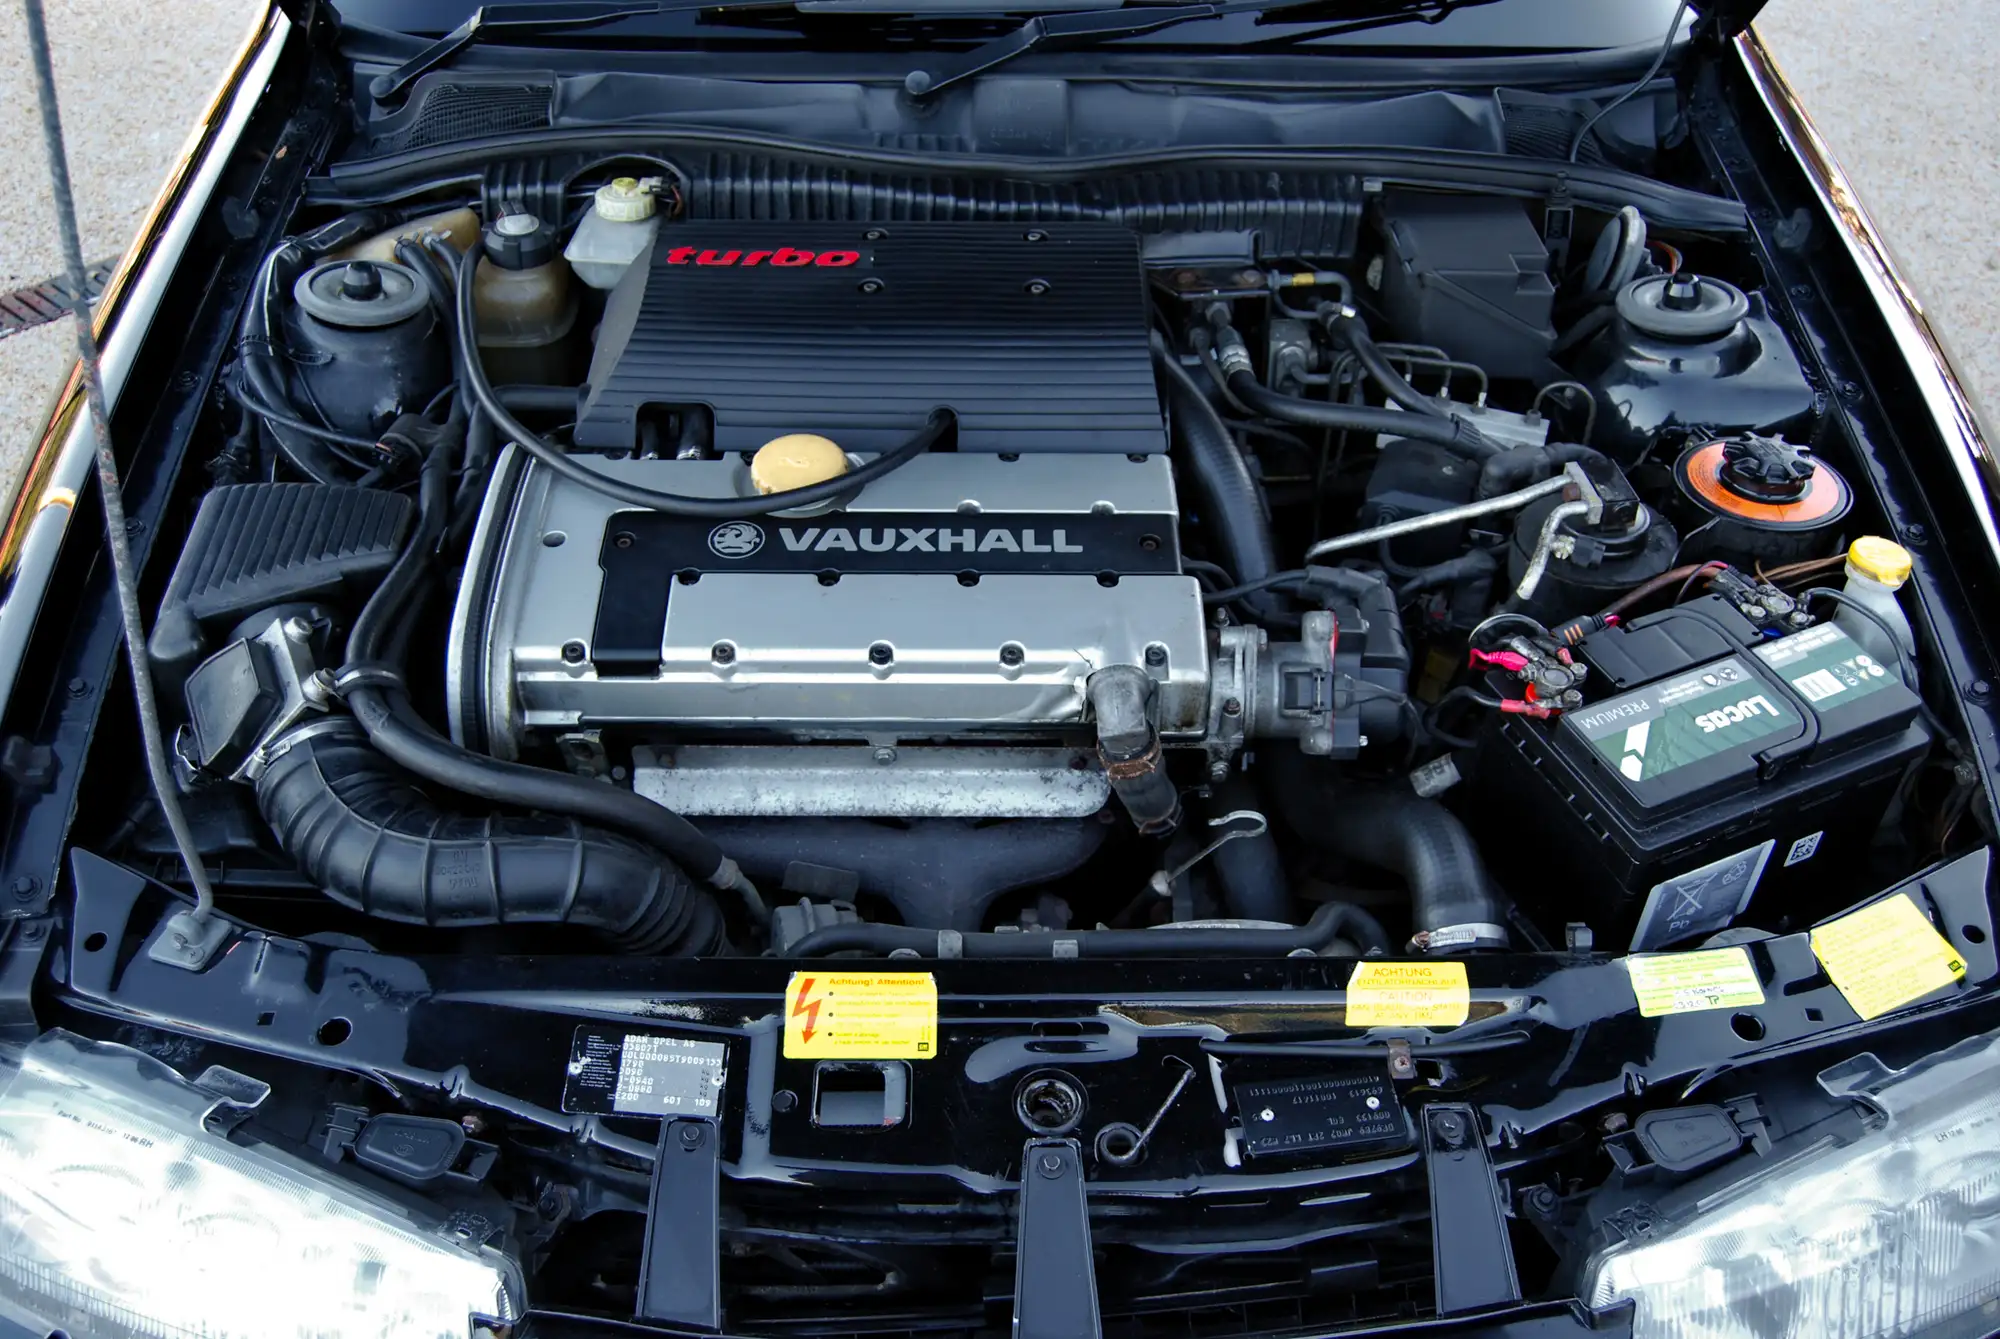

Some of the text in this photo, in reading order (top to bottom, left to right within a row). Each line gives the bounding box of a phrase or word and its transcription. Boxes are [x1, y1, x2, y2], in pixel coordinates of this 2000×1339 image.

[667, 246, 860, 267] turbo
[779, 527, 1083, 553] VAUXHALL
[1581, 699, 1650, 729] PREMIUM
[1695, 694, 1780, 733] Lucas
[1373, 967, 1433, 977] ACHTUNG
[829, 978, 925, 987] Achtung! Attention!
[624, 1034, 648, 1044] ADAM
[653, 1036, 677, 1047] OPEL
[663, 1095, 681, 1105] 601
[695, 1098, 711, 1107] 109
